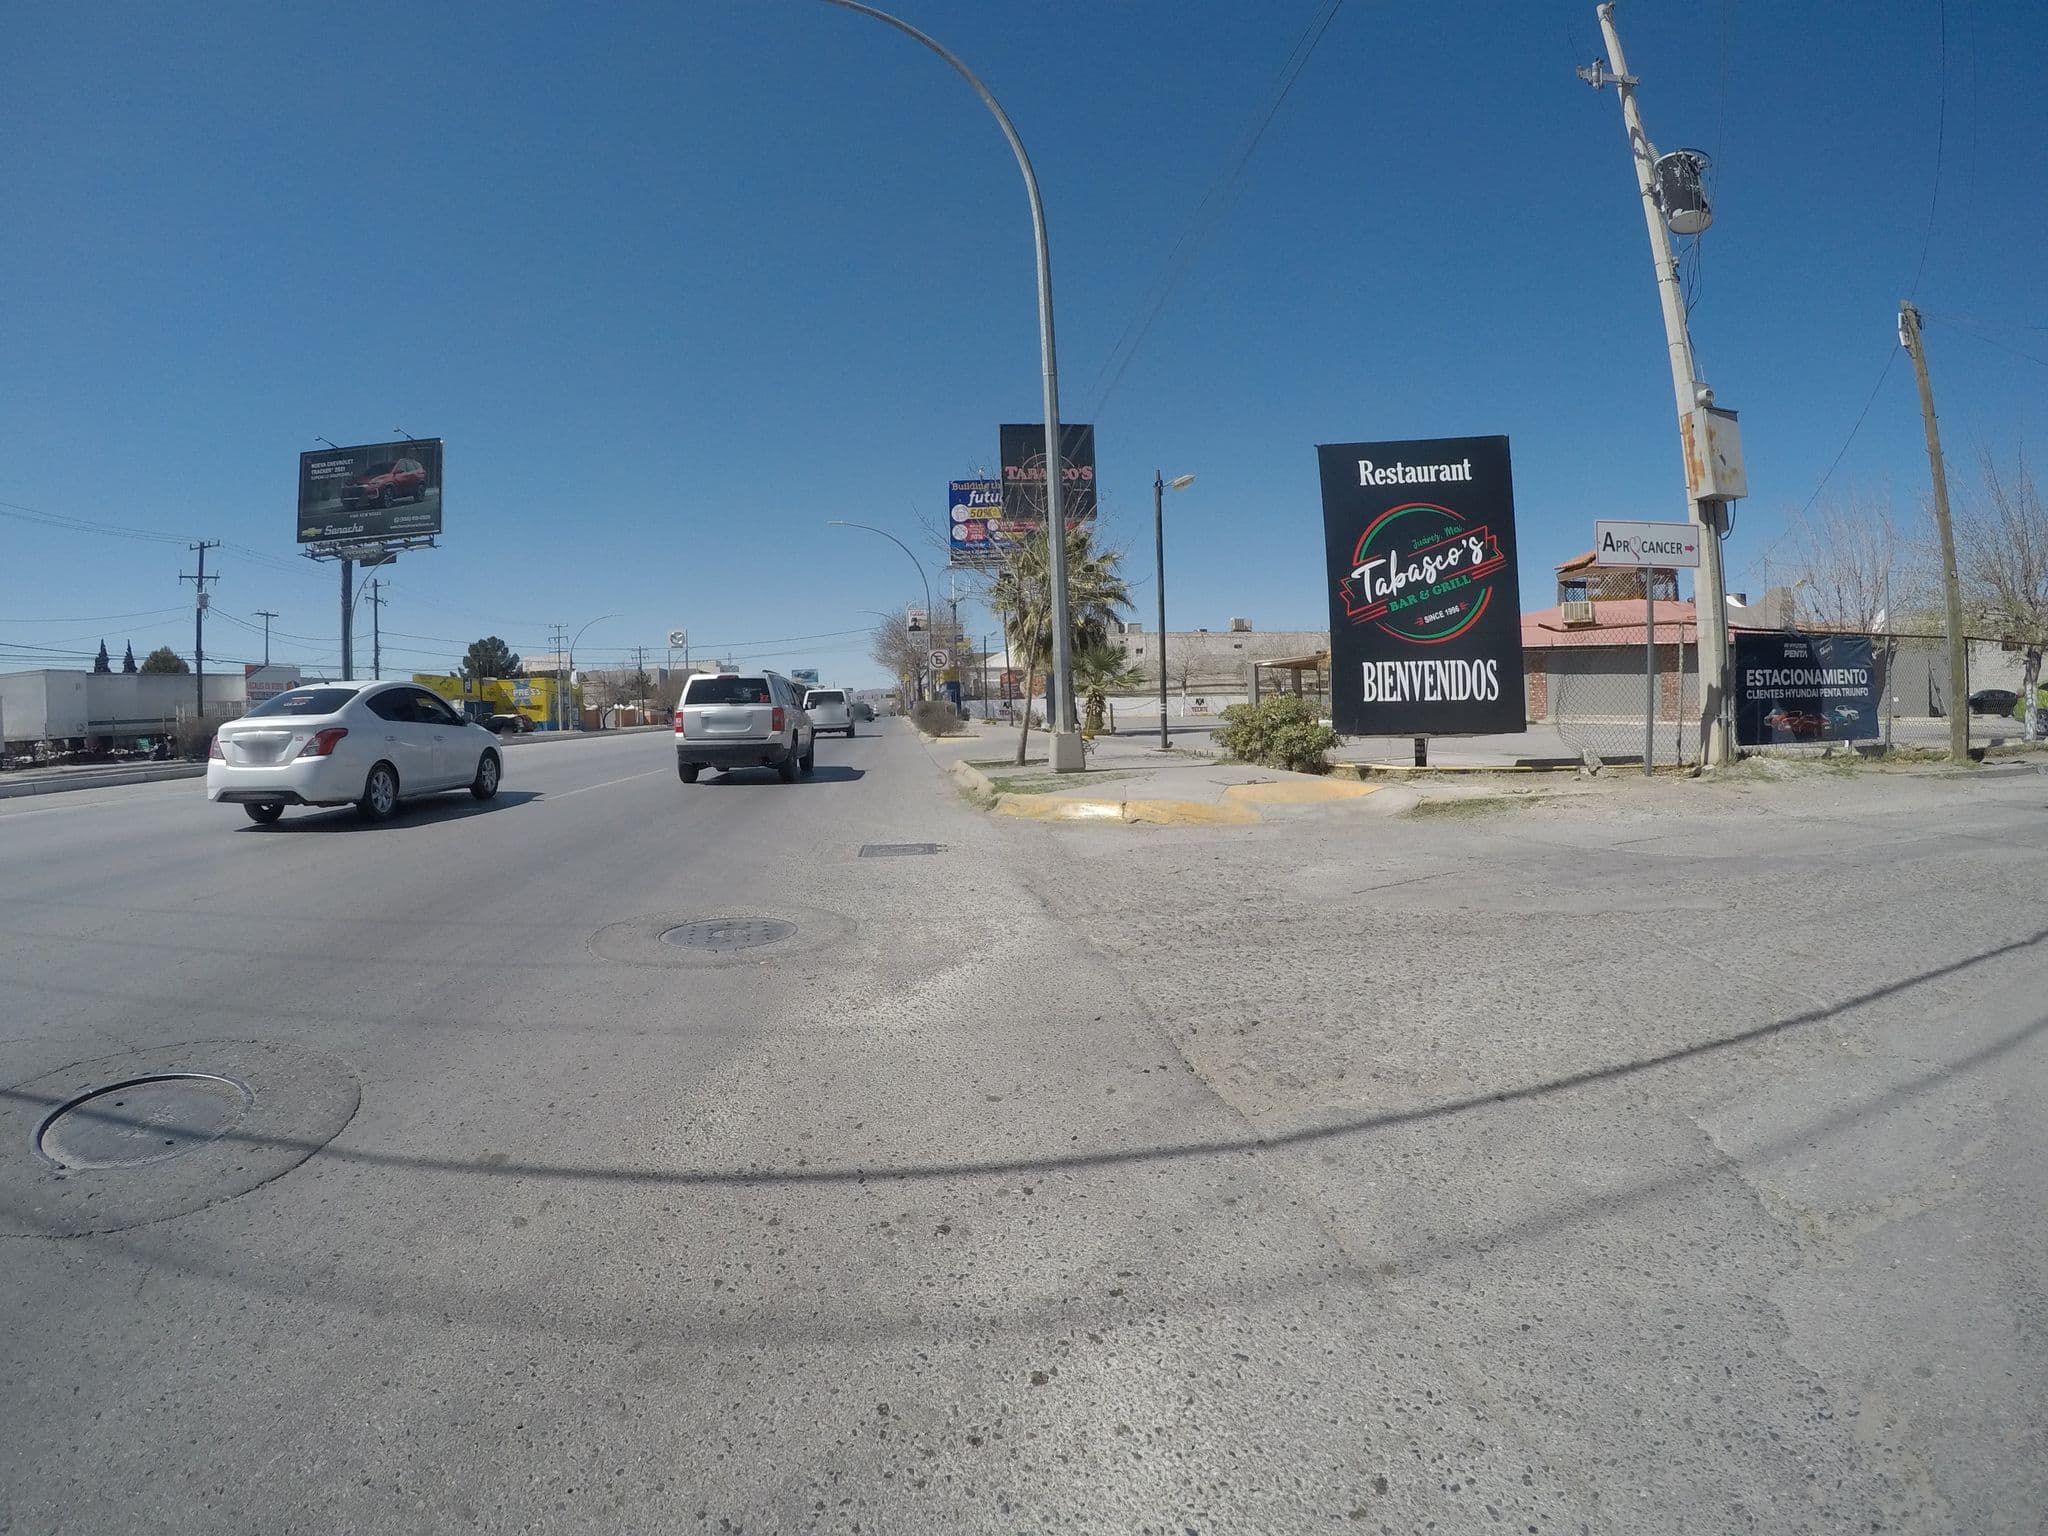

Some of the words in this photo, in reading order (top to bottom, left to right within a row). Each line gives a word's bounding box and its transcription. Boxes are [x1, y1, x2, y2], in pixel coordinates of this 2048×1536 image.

[1005, 465, 1093, 480] TABACO'S
[1359, 458, 1472, 486] Restaurant
[952, 482, 990, 491] Building
[1351, 536, 1484, 603] Tabasco's
[1388, 594, 1418, 612] BAR
[1419, 589, 1430, 600] &
[1432, 574, 1472, 595] GRILL
[1423, 610, 1445, 624] SINCE
[1784, 649, 1808, 658] PENTA
[1362, 659, 1500, 703] BIENVENIDOS
[1746, 668, 1868, 687] ESTACIONAMIENTO
[1746, 689, 1785, 699] CLIENTES
[1786, 688, 1819, 698] HYUNDAI
[1820, 687, 1842, 697] PENTA
[1842, 687, 1869, 697] TRIUNFO
